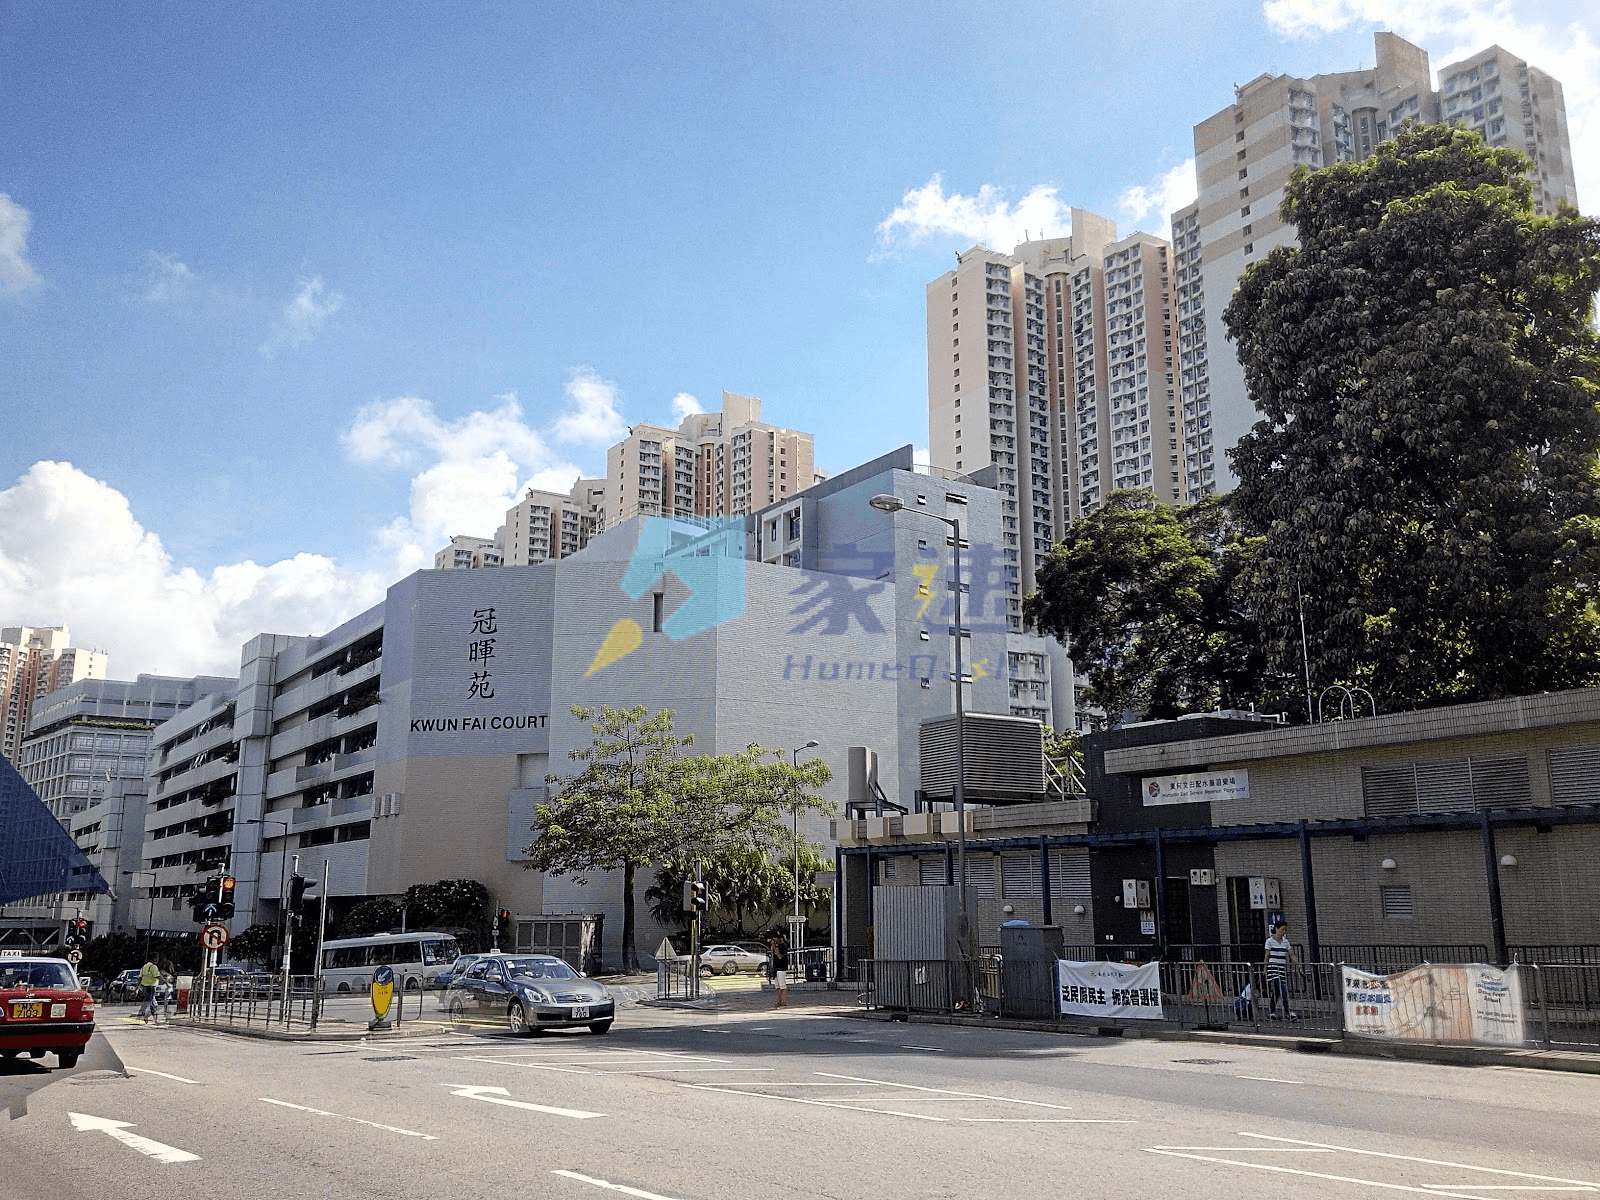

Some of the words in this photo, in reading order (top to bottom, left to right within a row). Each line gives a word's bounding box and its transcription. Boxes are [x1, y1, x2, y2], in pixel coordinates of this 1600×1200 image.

[467, 607, 498, 700] 冠暉苑
[410, 719, 458, 732] KWUN
[462, 717, 486, 730] FAI
[490, 715, 548, 729] COURT
